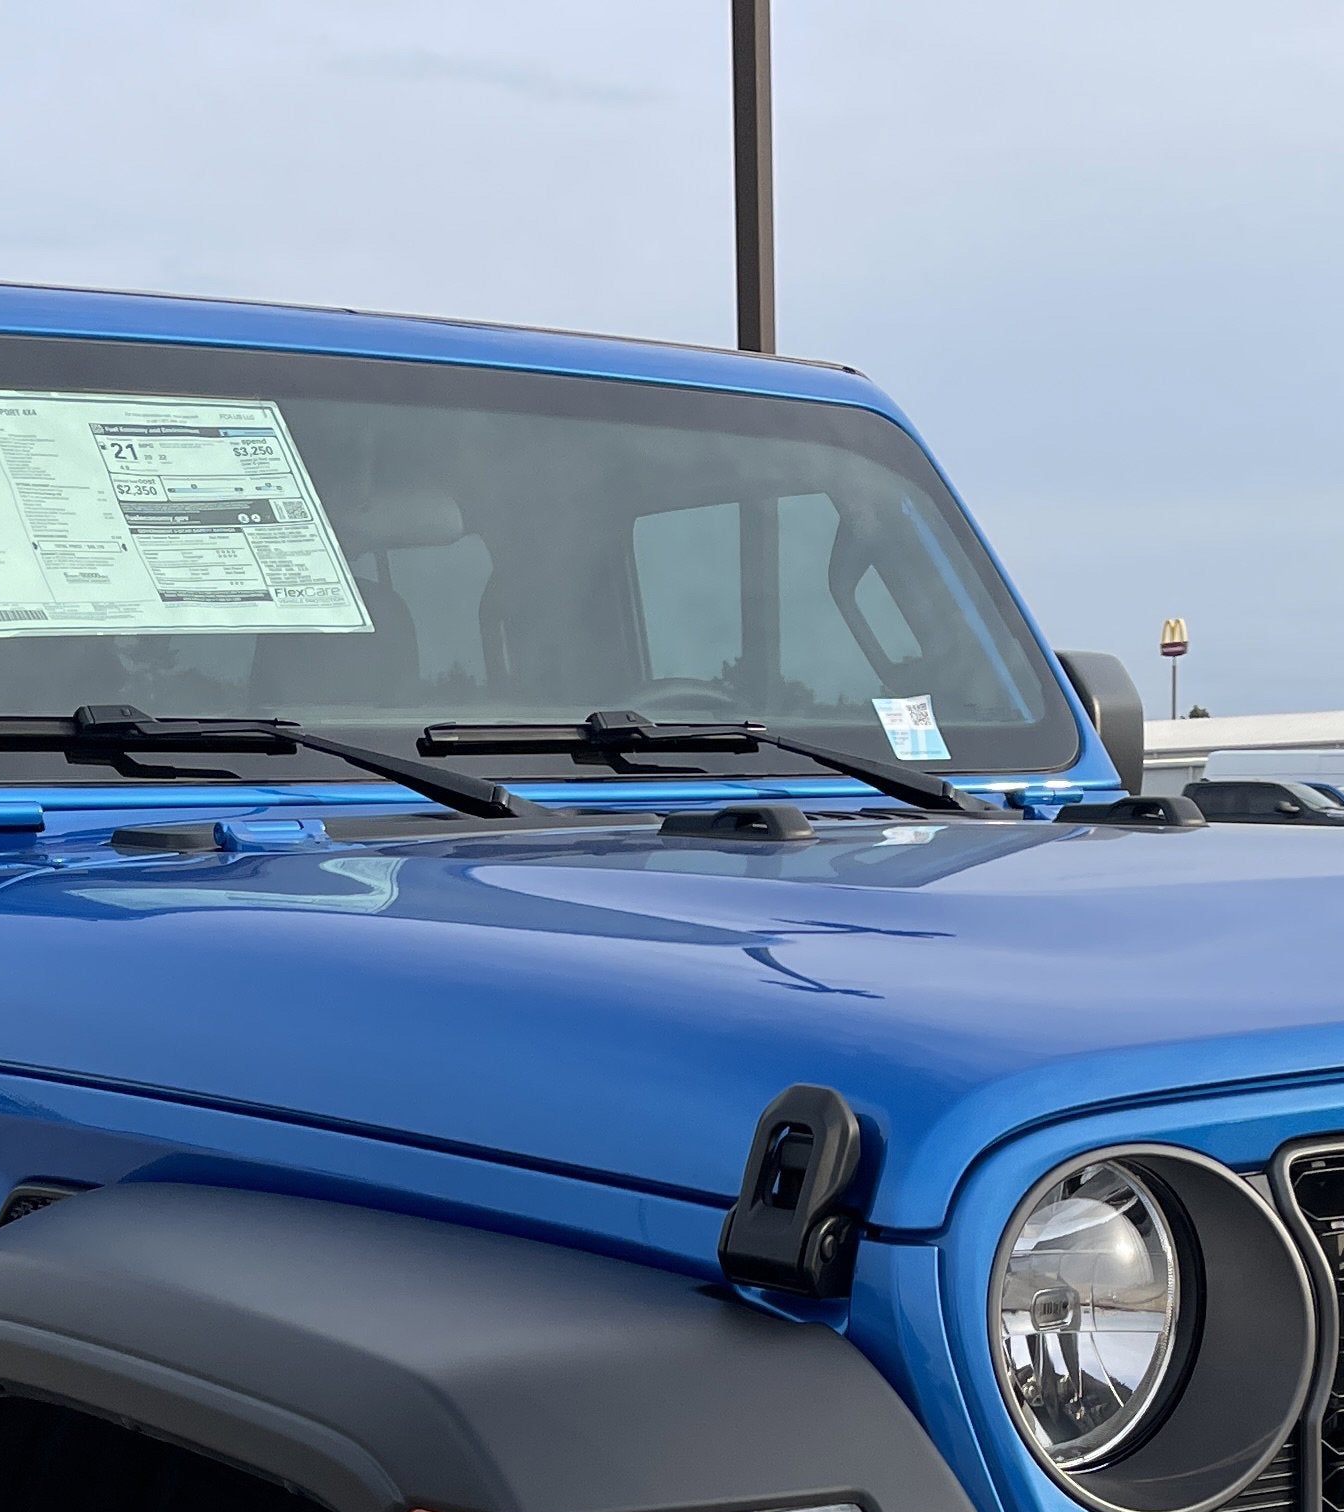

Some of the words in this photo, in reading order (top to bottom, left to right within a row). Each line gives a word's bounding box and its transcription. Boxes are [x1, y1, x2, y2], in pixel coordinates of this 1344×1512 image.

[110, 442, 138, 461] 21
[233, 445, 274, 458] $3,250
[116, 484, 158, 497] $2,350
[274, 586, 340, 598] FlexCare
